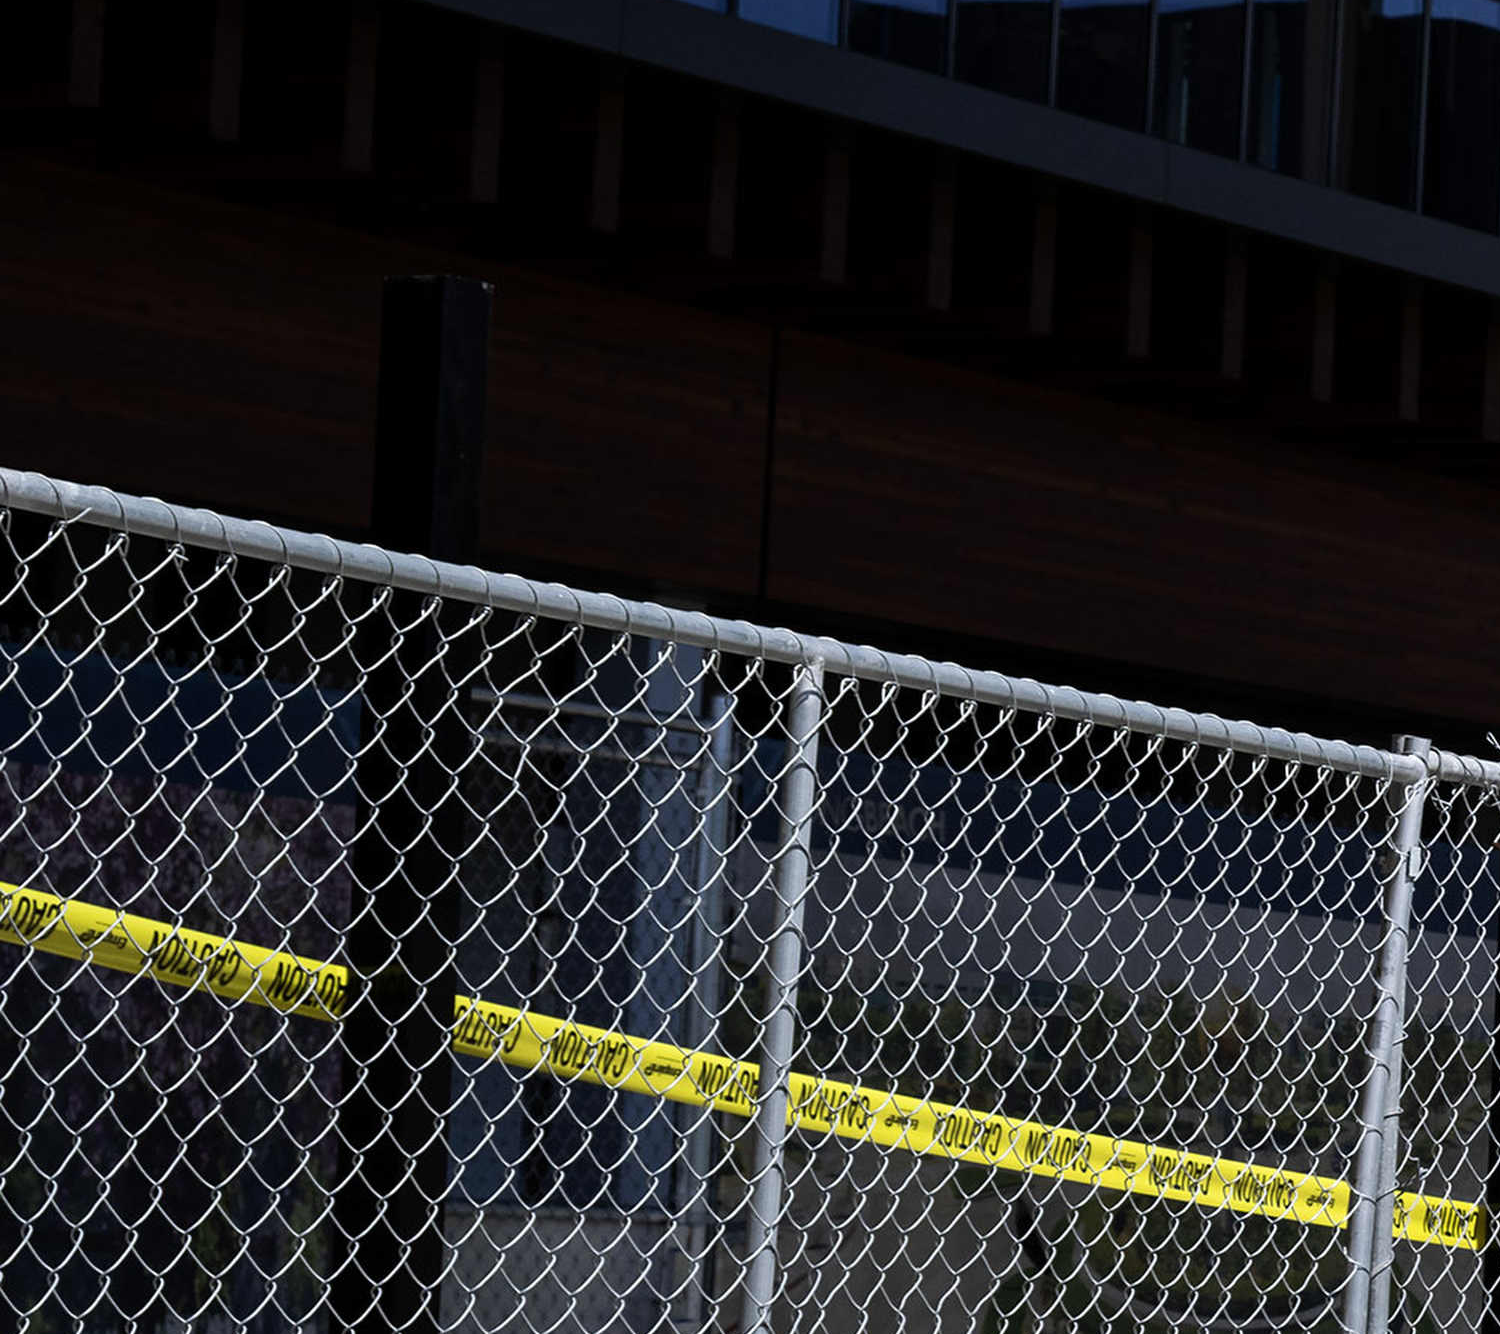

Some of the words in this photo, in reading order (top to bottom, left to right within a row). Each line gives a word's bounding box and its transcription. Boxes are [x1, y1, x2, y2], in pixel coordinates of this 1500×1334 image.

[142, 931, 241, 987] CAUTION
[267, 962, 347, 1012] AUTION
[453, 1004, 522, 1055] CAUTIO
[547, 1028, 629, 1079] CAUTION
[696, 1060, 759, 1106] AUTION
[799, 1083, 870, 1130] CAUTION
[932, 1112, 1001, 1157] CAUTION
[1025, 1130, 1092, 1173] CAUTION
[1149, 1155, 1212, 1196] CAUTION
